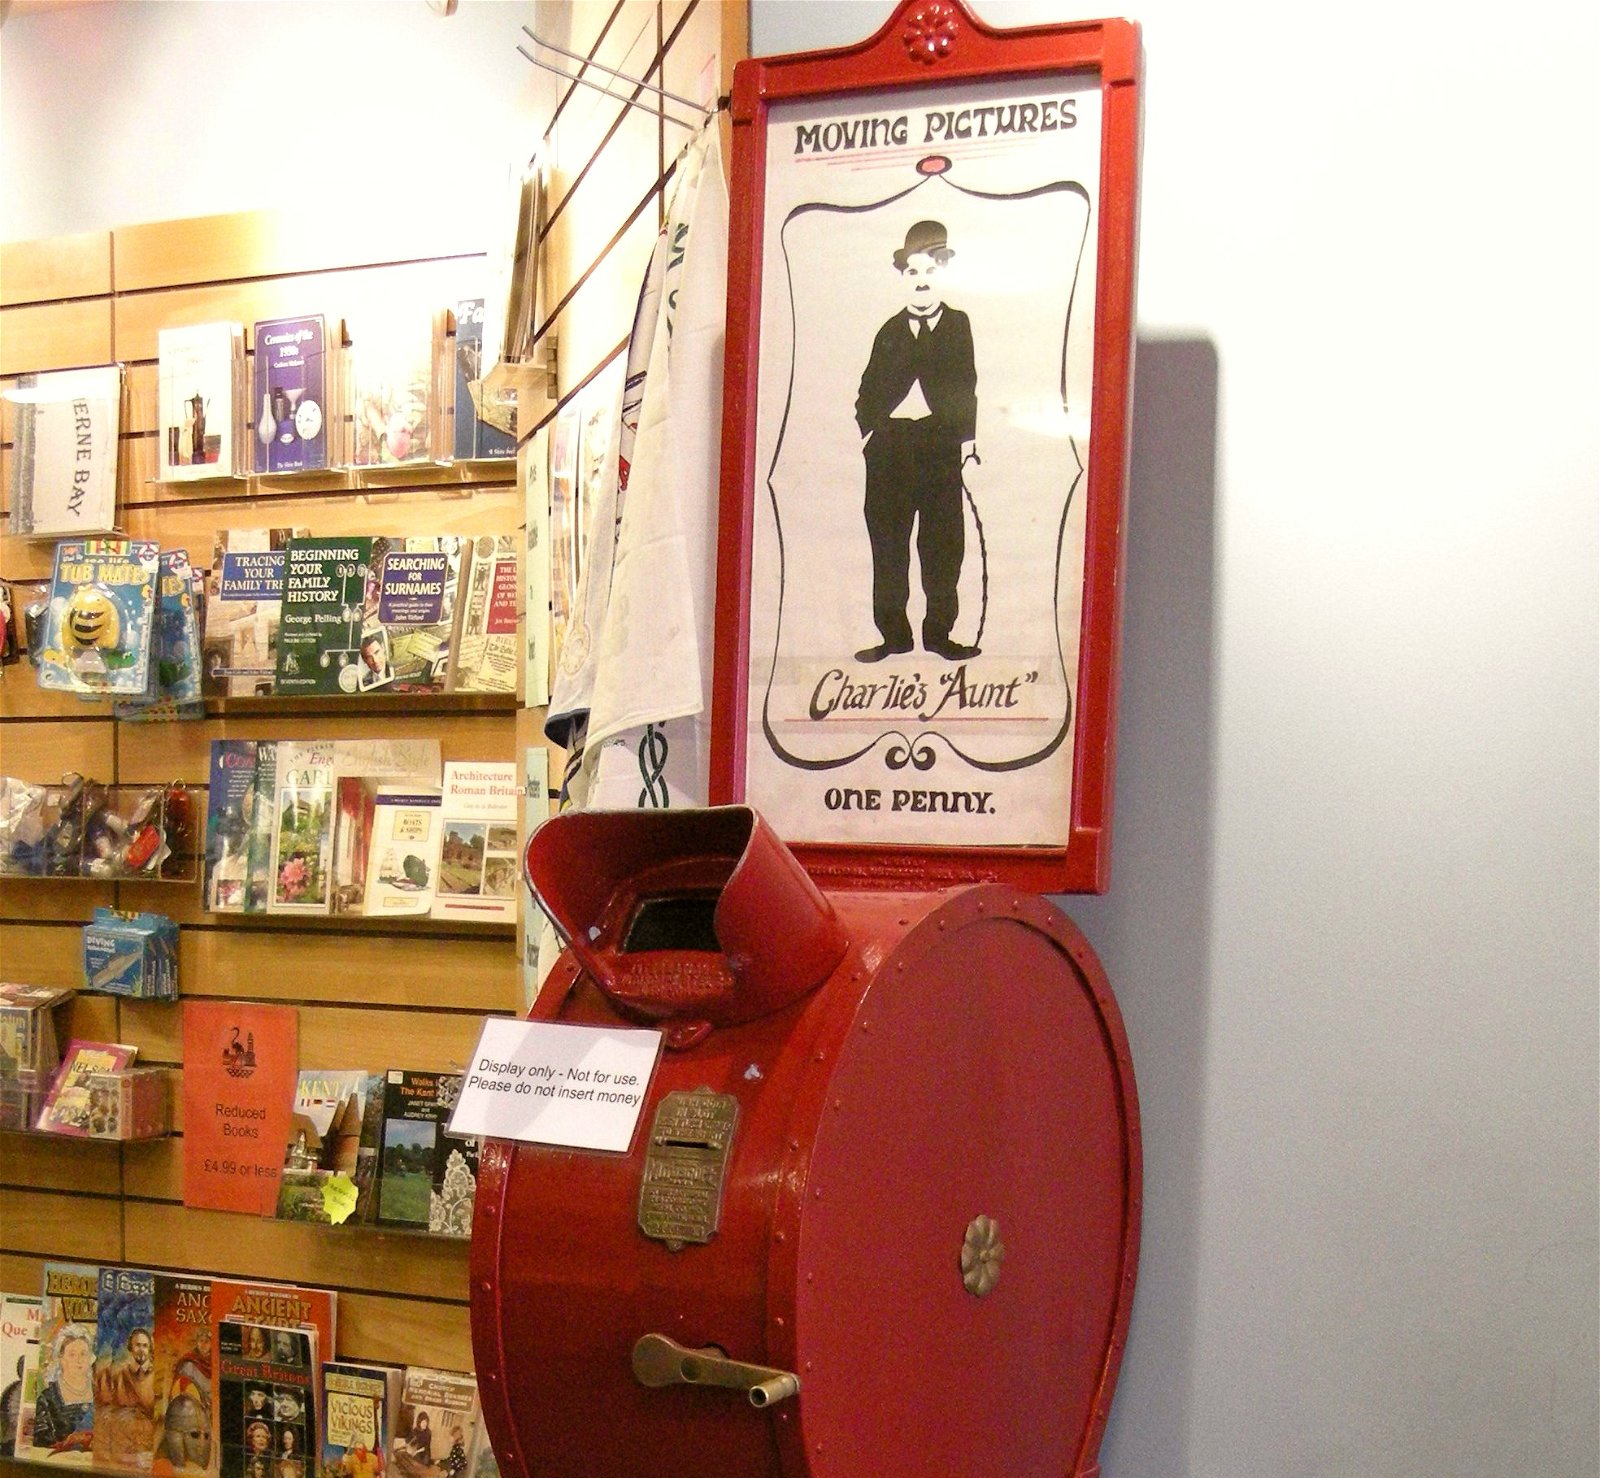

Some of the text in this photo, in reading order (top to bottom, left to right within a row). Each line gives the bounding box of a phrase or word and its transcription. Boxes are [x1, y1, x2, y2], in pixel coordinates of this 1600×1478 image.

[794, 98, 1078, 155] MOVING PICTURES
[66, 469, 91, 518] BAY
[236, 556, 285, 567] TRACING
[290, 549, 359, 562] BEGINNING
[290, 563, 323, 575] YOUR
[386, 558, 446, 571] SEARCHING
[244, 568, 274, 579] YOUR
[408, 572, 422, 582] FOR
[224, 580, 262, 591] FAMILY
[288, 576, 332, 589] FAMILY
[384, 582, 442, 596] SURNAMES
[286, 590, 339, 603] HISTORY
[284, 614, 312, 624] George
[809, 668, 930, 721] Charlie's
[450, 770, 514, 782] Architecture
[450, 784, 488, 796] Roman
[478, 1058, 526, 1078] Display
[528, 1065, 556, 1082] only
[566, 1068, 591, 1082] Not
[593, 1070, 612, 1084] for
[613, 1074, 640, 1086] use.
[468, 1076, 642, 1108] Please do not insert money
[216, 1103, 266, 1120] Reduced
[224, 1123, 258, 1138] Books
[204, 1158, 278, 1178] £4.99 or less
[232, 1296, 312, 1320] ANCIENT
